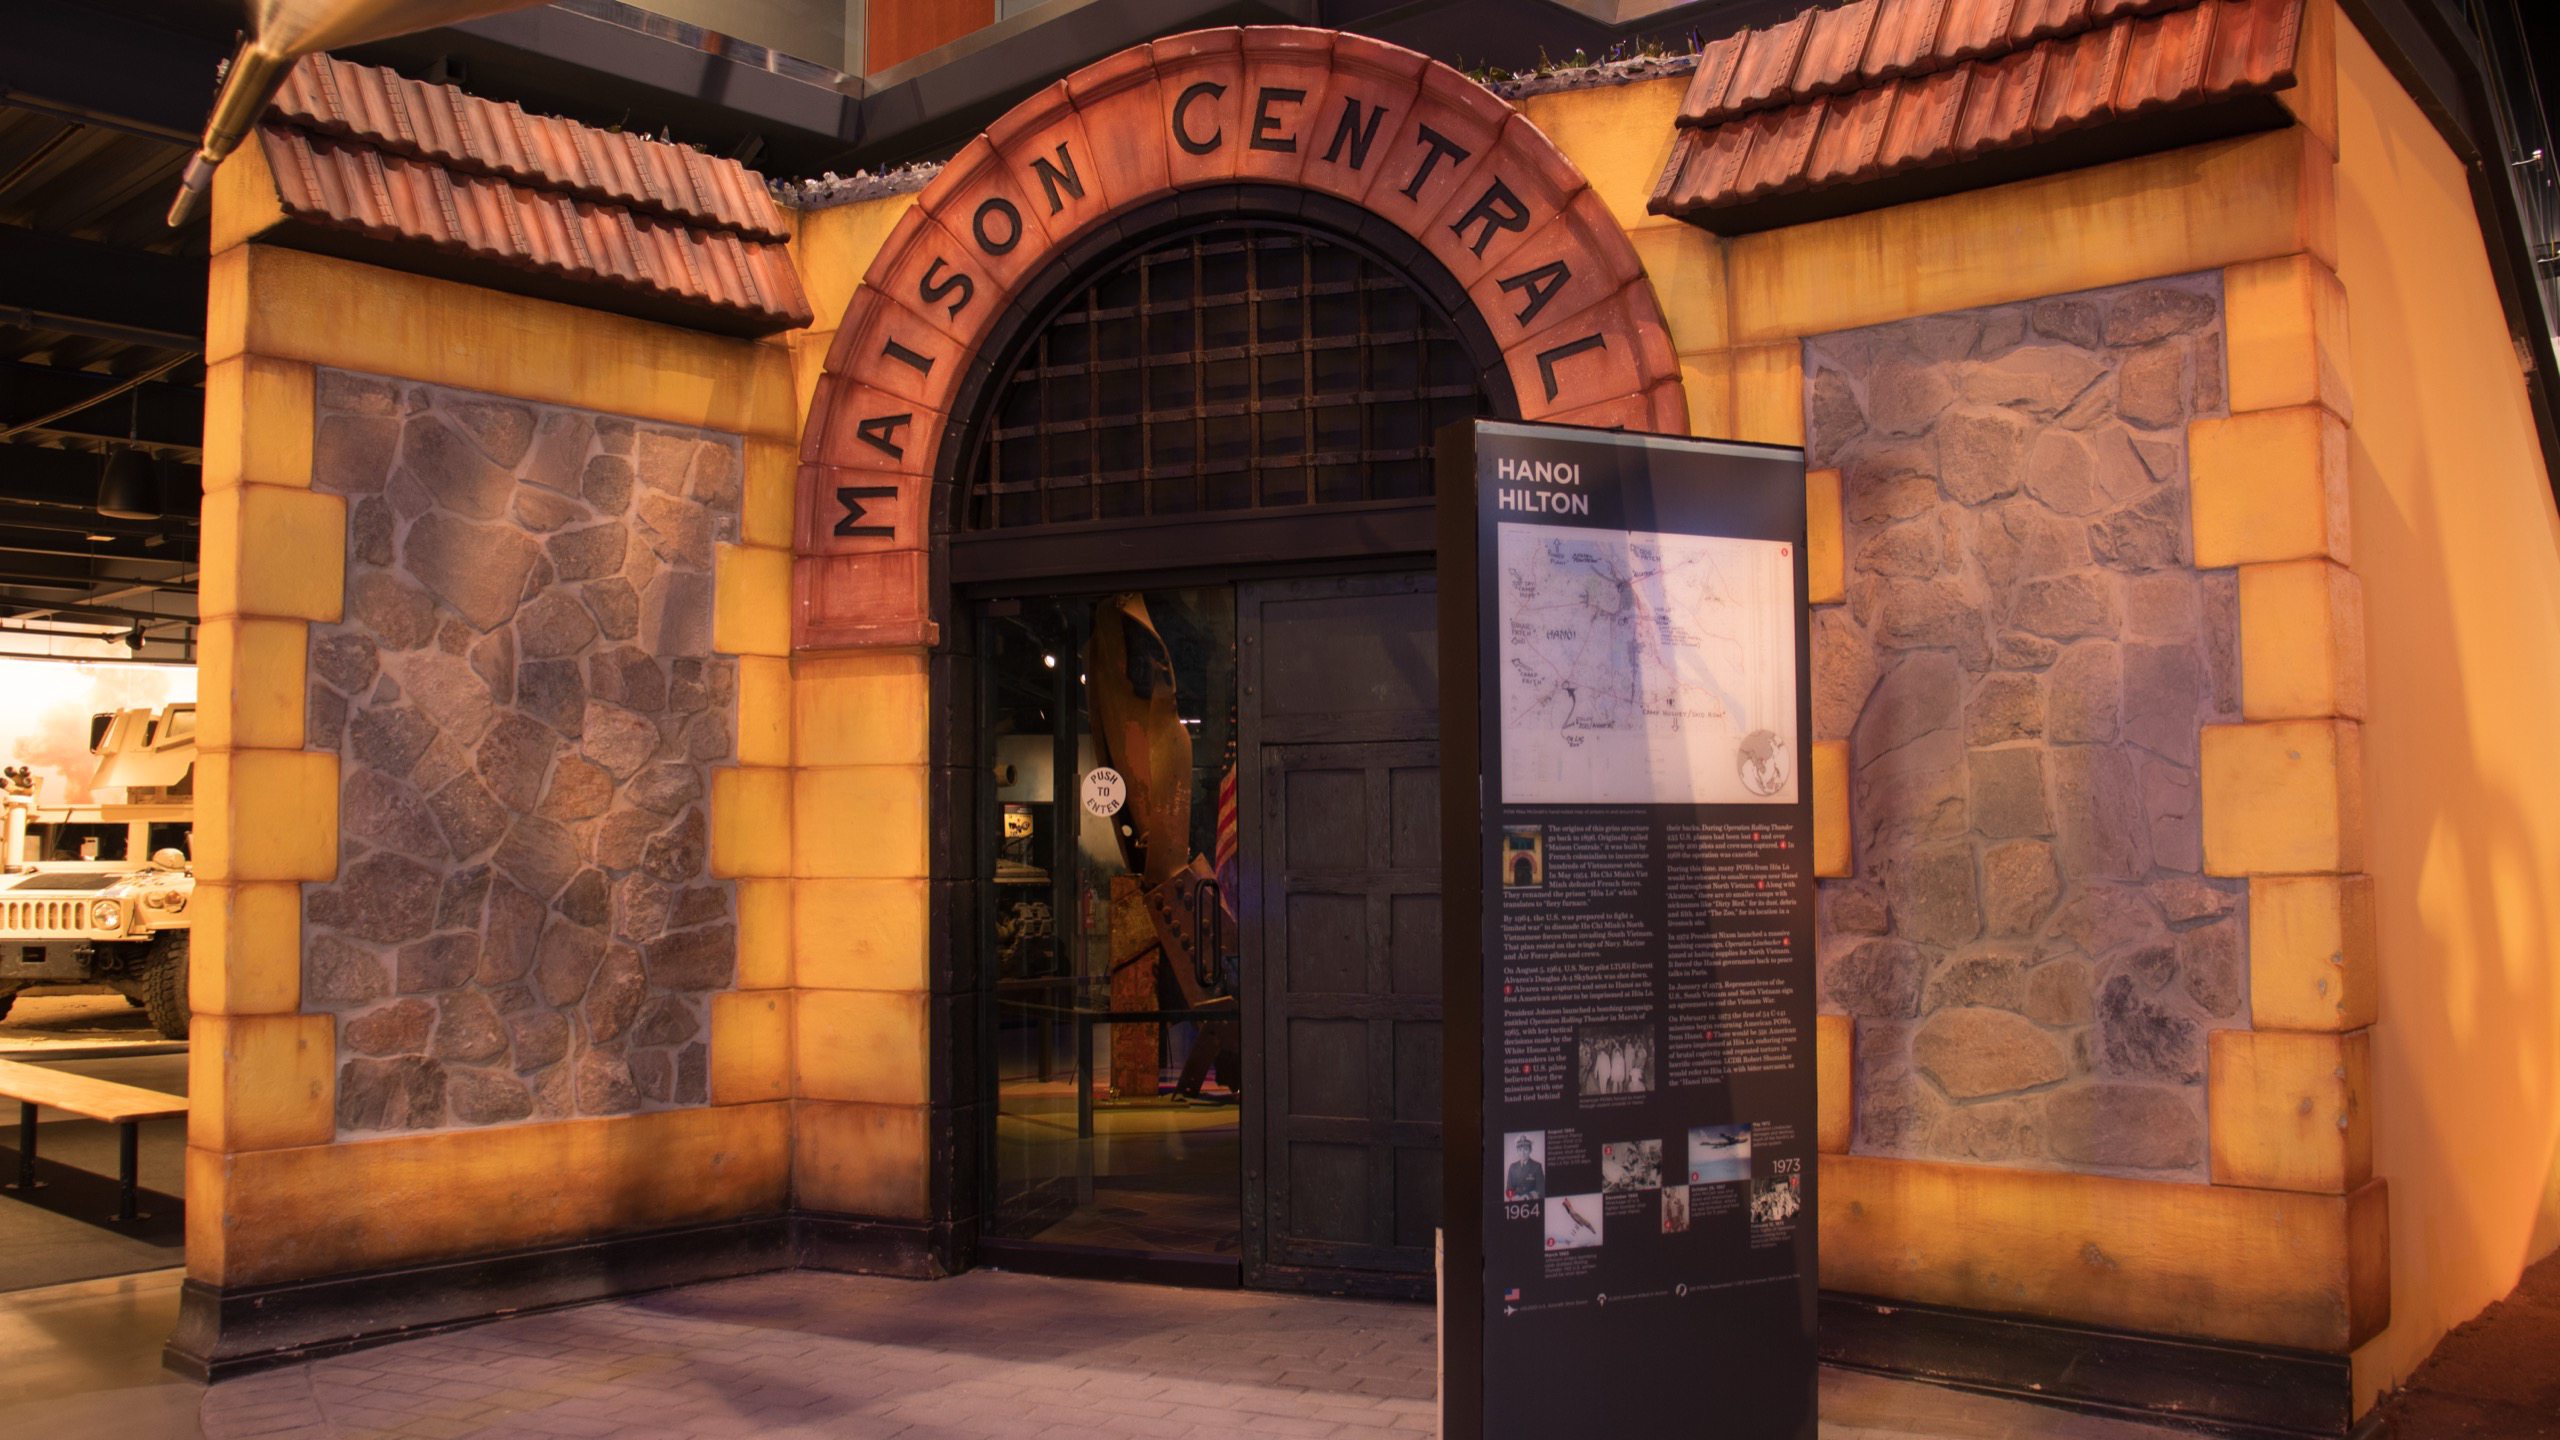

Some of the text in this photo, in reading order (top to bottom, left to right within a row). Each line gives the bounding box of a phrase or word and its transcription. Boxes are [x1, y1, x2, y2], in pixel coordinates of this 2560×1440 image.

[834, 82, 1624, 540] MAISON CENTRAL
[1498, 458, 1580, 486] HANOI
[1498, 488, 1589, 515] HILTON
[1090, 770, 1118, 784] PUSH
[1097, 786, 1110, 797] TO
[1086, 798, 1120, 814] ENTER
[1772, 1158, 1801, 1174] 1973
[1504, 1204, 1540, 1220] 1964
